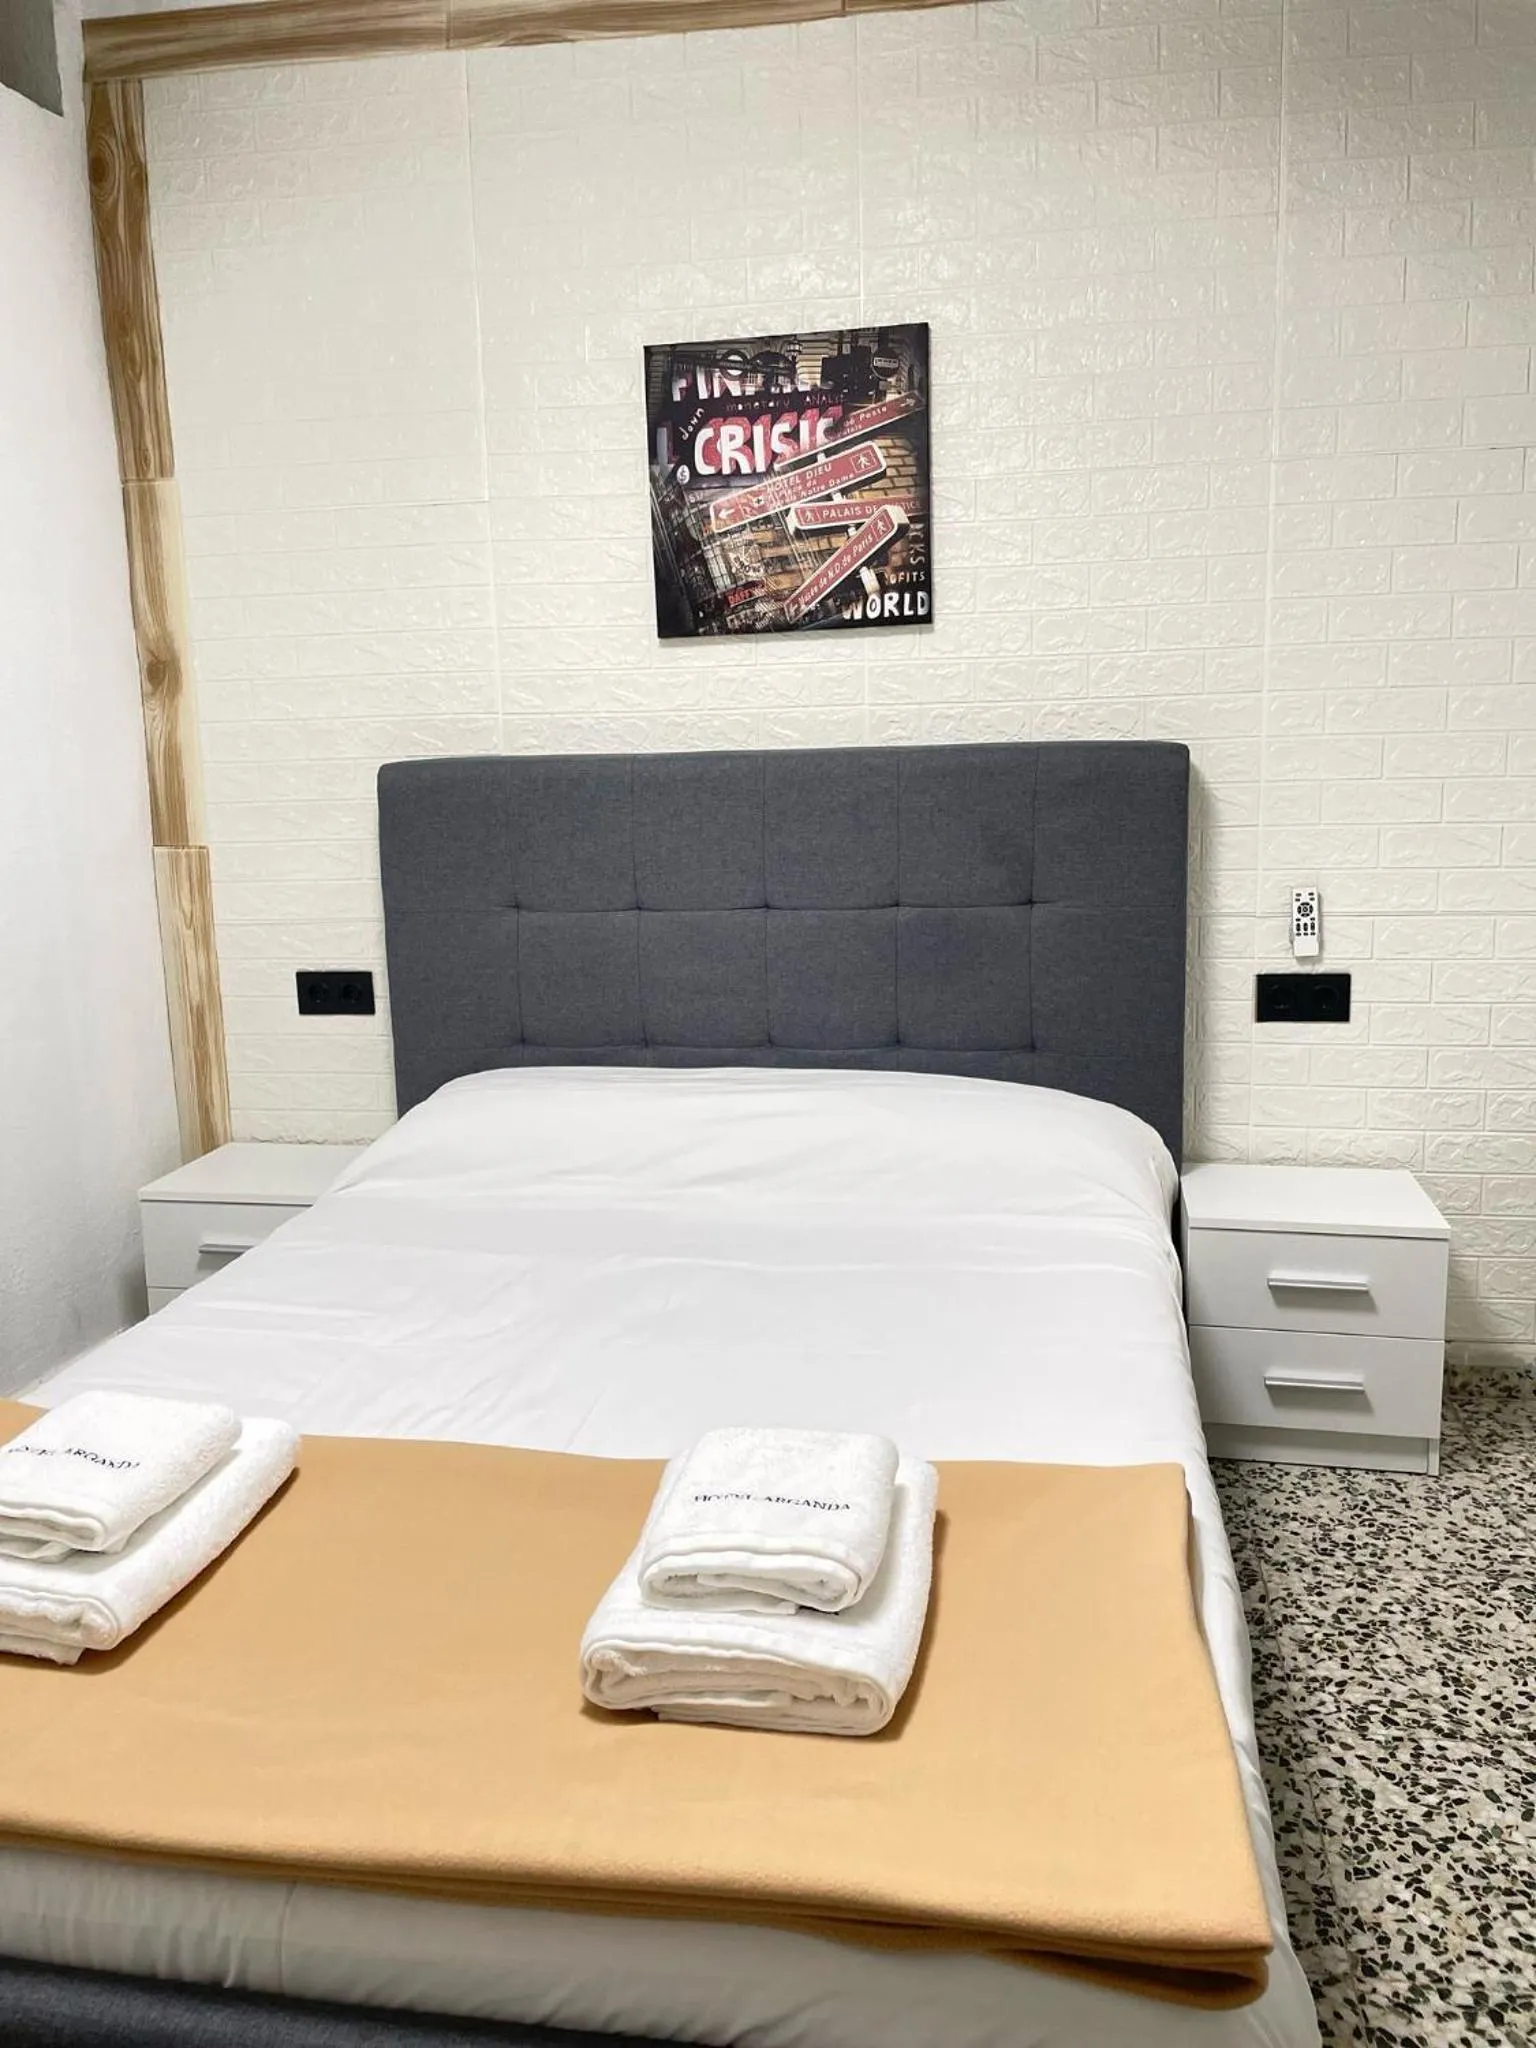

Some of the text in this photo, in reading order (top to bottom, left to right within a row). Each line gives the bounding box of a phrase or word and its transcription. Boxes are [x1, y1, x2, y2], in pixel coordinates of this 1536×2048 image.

[805, 463, 833, 480] DIEU
[829, 473, 855, 487] Dame
[822, 507, 863, 518] PALAIS
[852, 534, 874, 557] Paris
[842, 591, 930, 620] WORLD
